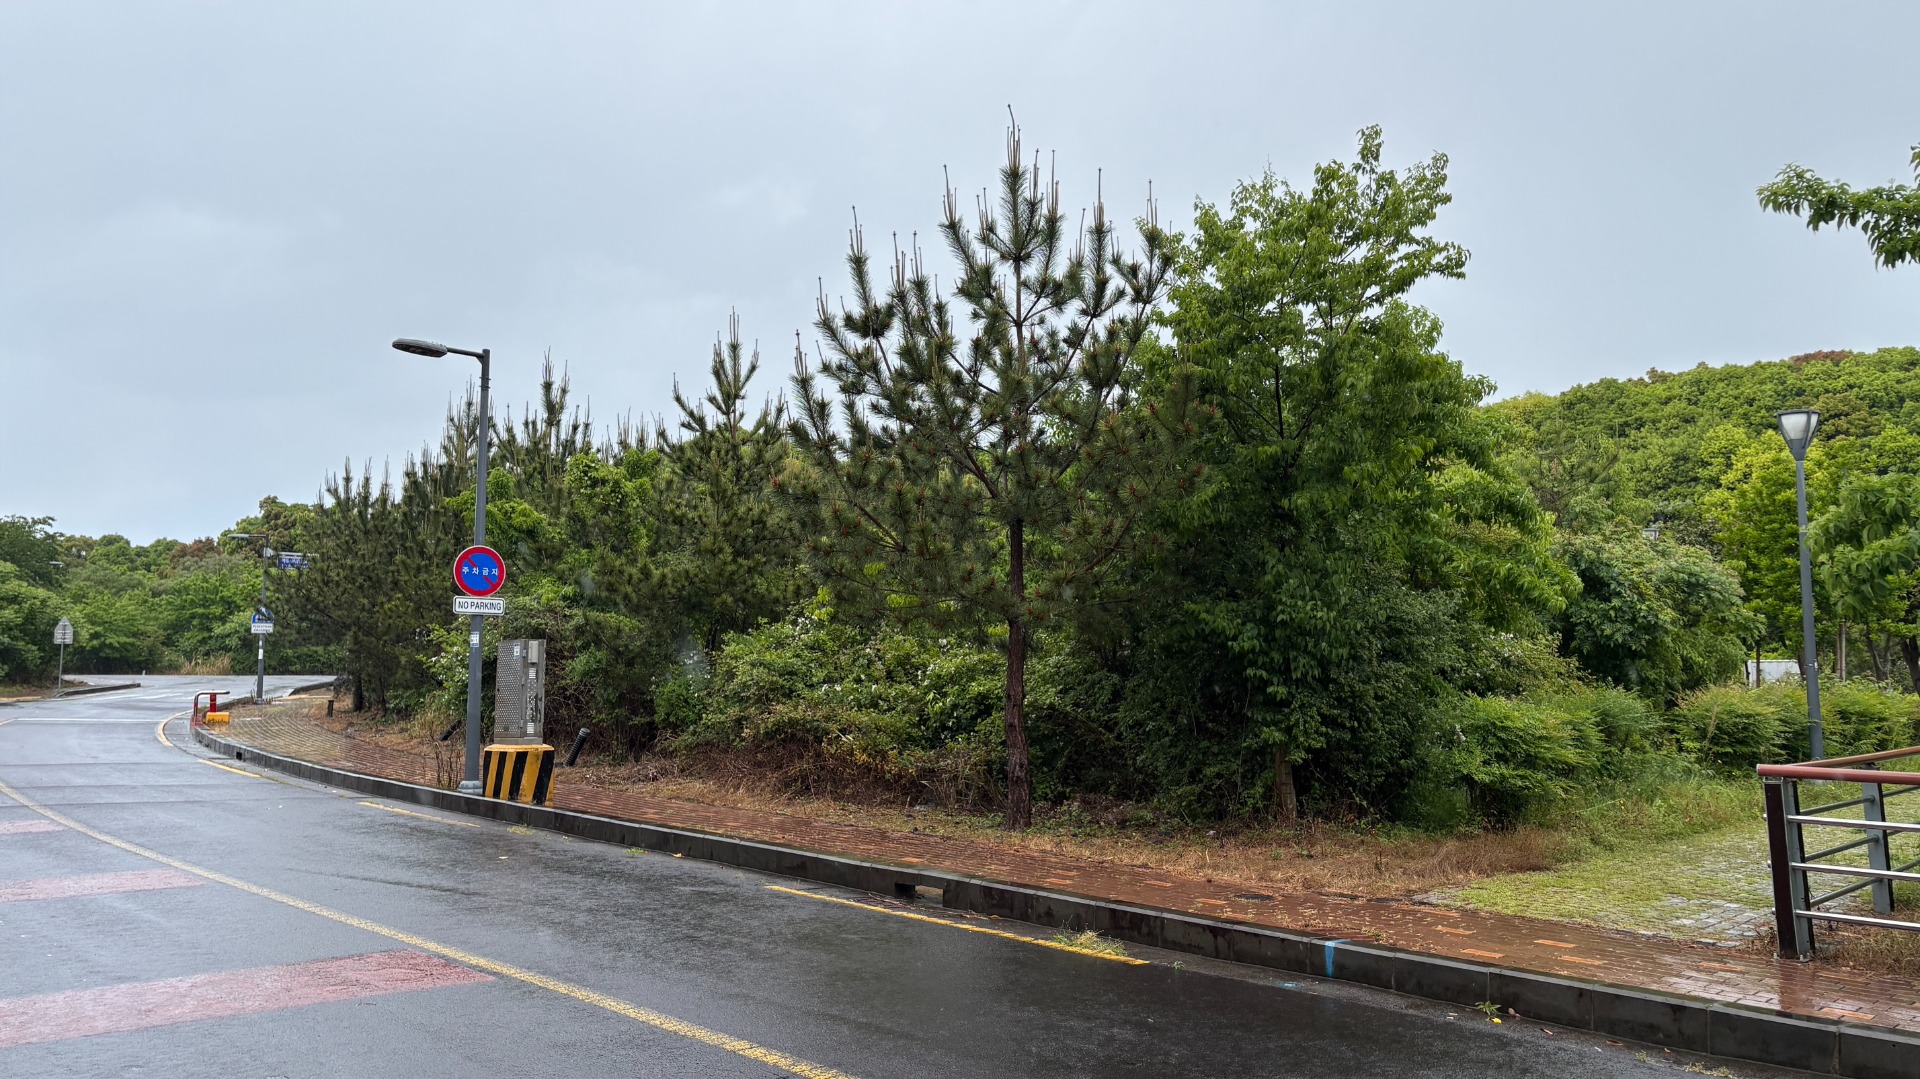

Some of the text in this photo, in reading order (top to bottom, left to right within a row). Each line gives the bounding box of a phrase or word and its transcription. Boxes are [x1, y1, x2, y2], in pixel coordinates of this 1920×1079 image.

[462, 566, 498, 576] 주차금지
[458, 601, 502, 610] NO PARKING
